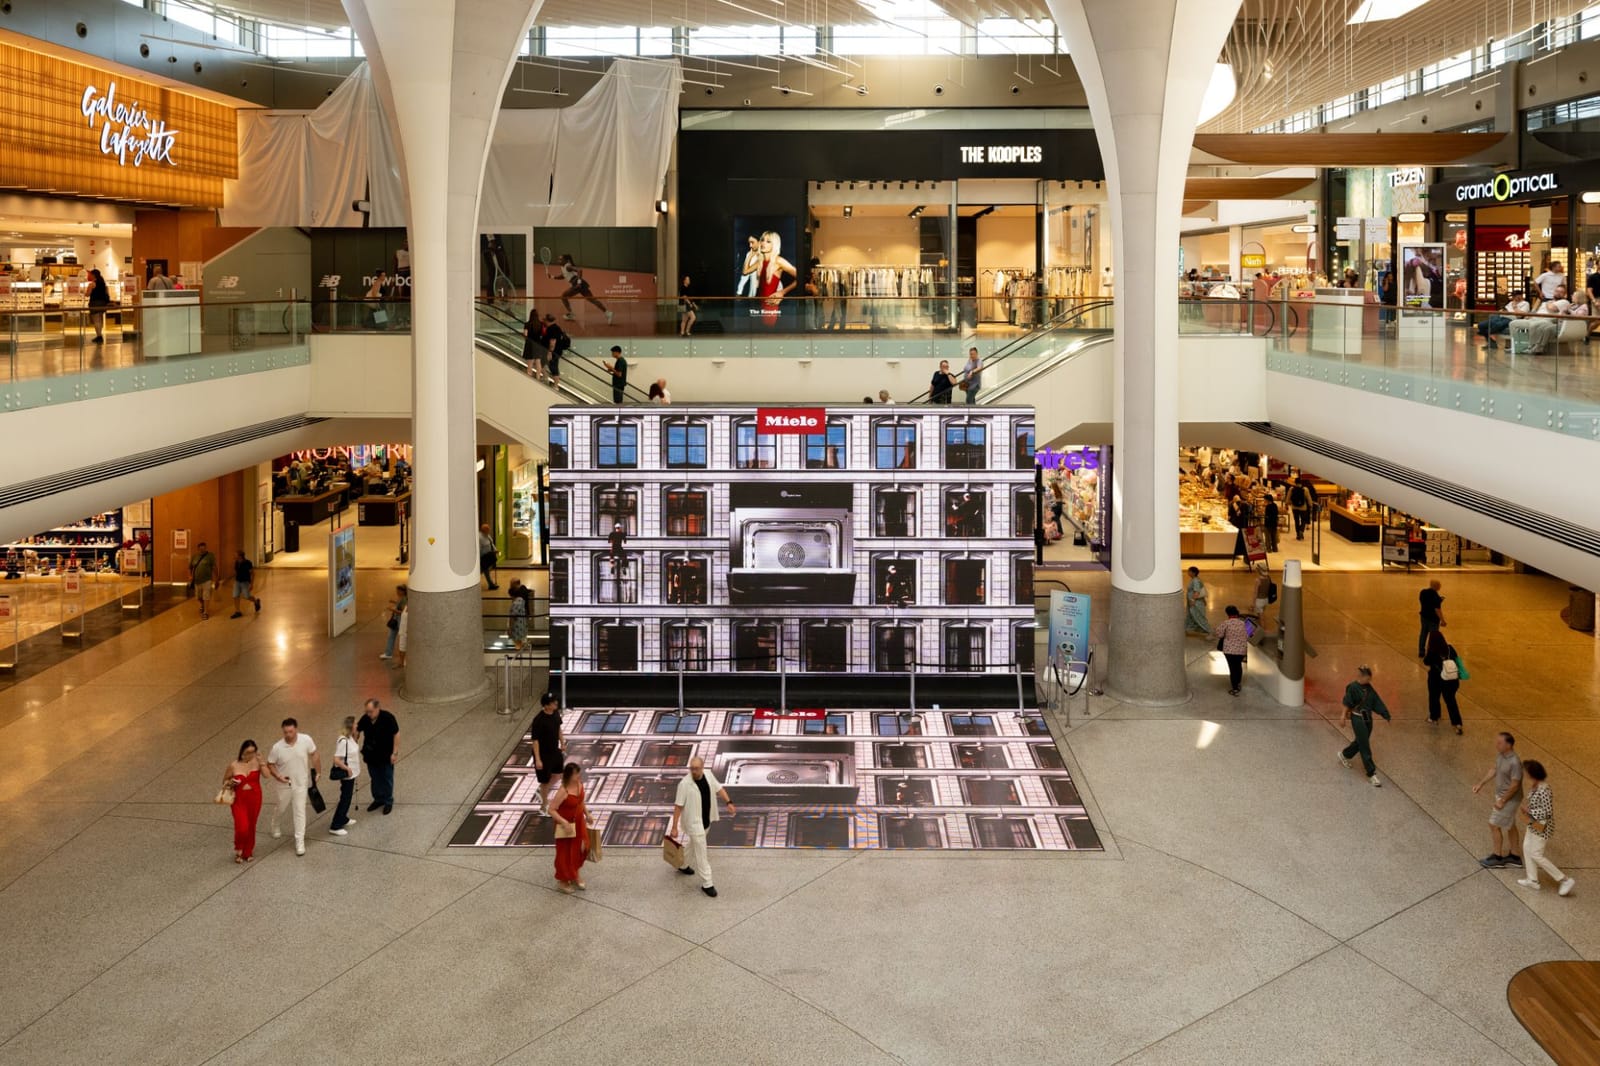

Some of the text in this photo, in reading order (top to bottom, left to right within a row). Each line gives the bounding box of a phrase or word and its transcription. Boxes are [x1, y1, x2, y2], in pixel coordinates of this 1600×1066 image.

[82, 81, 149, 129] Galeries
[101, 119, 179, 167] Lafayette
[960, 145, 1042, 163] THE KOOPLES
[765, 415, 818, 427] Miele
[291, 444, 413, 460] MONOPRI
